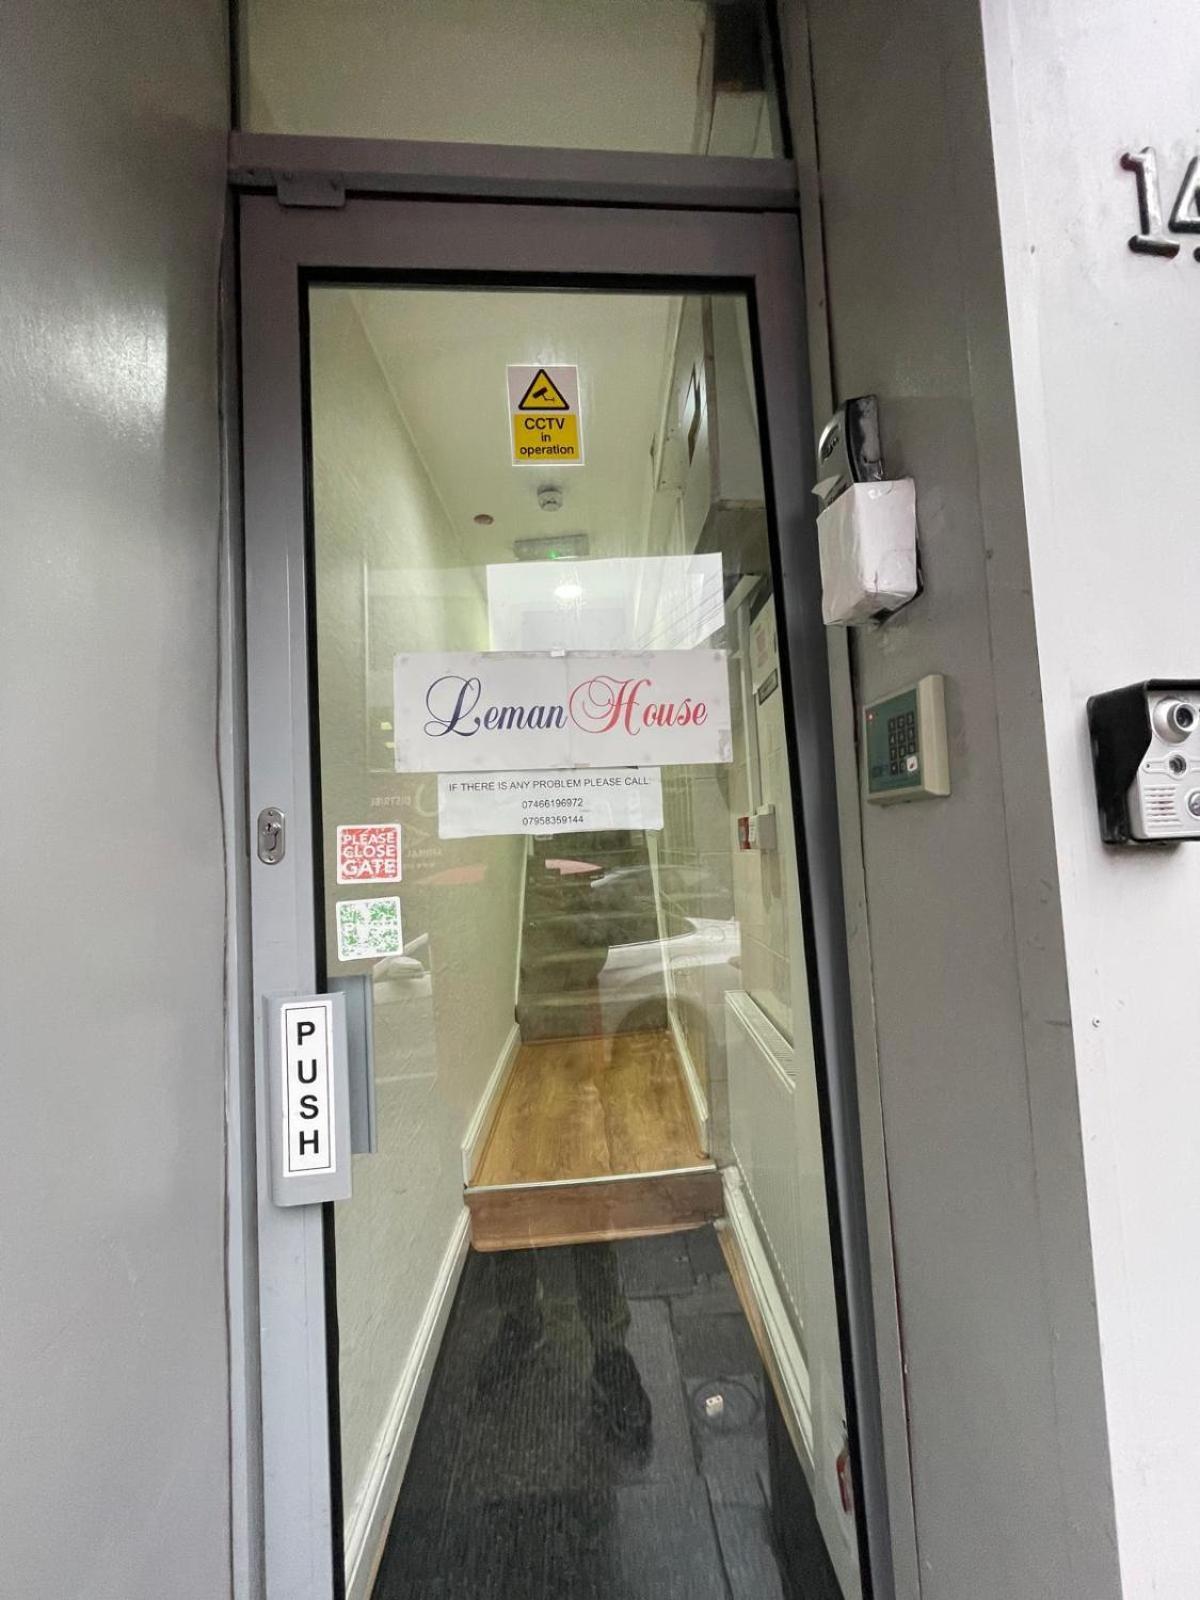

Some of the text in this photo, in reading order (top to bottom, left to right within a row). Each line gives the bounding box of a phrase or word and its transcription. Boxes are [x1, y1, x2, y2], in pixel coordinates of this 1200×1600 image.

[524, 417, 565, 430] CCTV
[541, 432, 551, 442] in
[519, 444, 574, 457] operation
[423, 675, 569, 737] Leman
[569, 675, 708, 736] House
[449, 783, 457, 791] IF
[462, 782, 495, 791] THERE
[499, 781, 508, 790] IS
[510, 780, 529, 790] ANY
[533, 779, 581, 789] PROBLEM
[584, 777, 622, 787] PLEASE
[343, 833, 395, 845] PLEASE
[343, 845, 396, 859] CLOSE
[342, 858, 397, 876] GATE
[297, 1021, 320, 1155] PUSH
